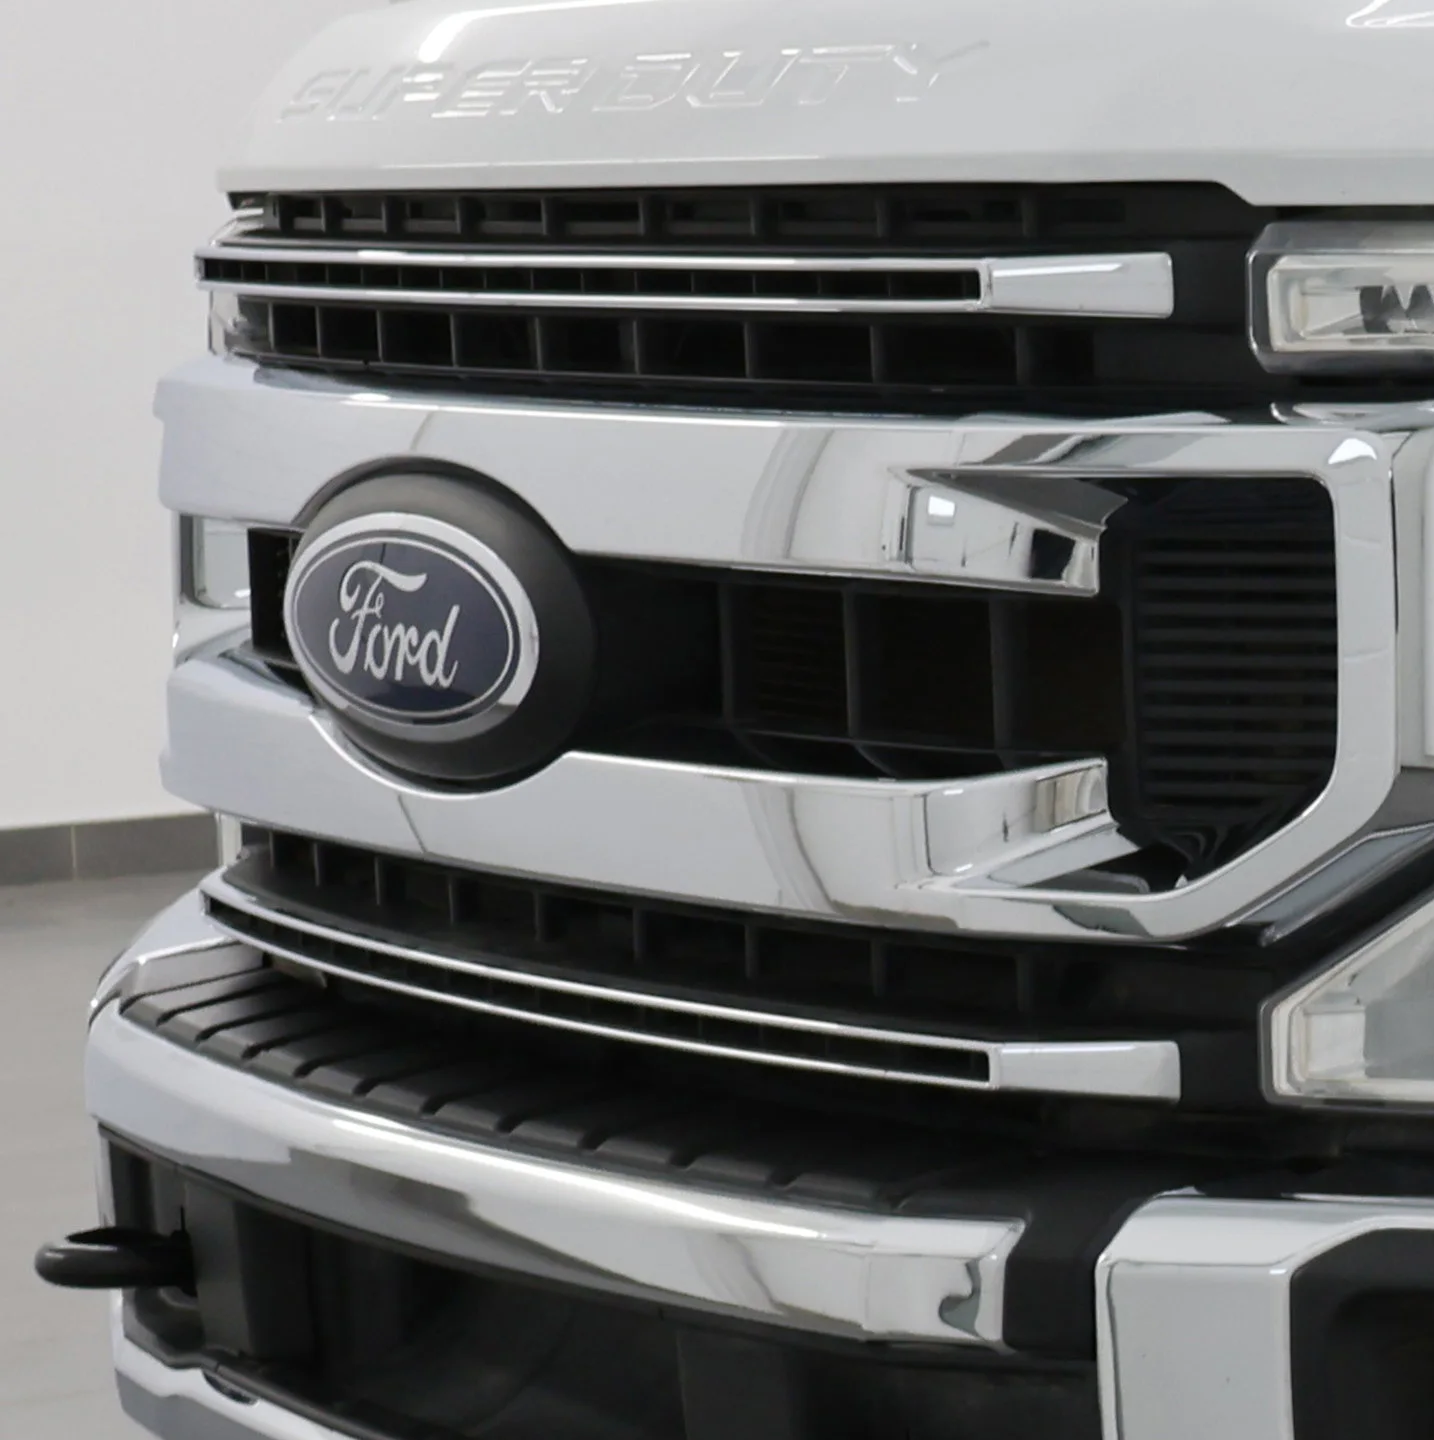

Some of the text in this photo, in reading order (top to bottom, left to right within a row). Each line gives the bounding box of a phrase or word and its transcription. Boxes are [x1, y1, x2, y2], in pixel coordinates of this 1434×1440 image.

[276, 41, 989, 123] SUPER DUTY
[328, 560, 460, 689] Ford
